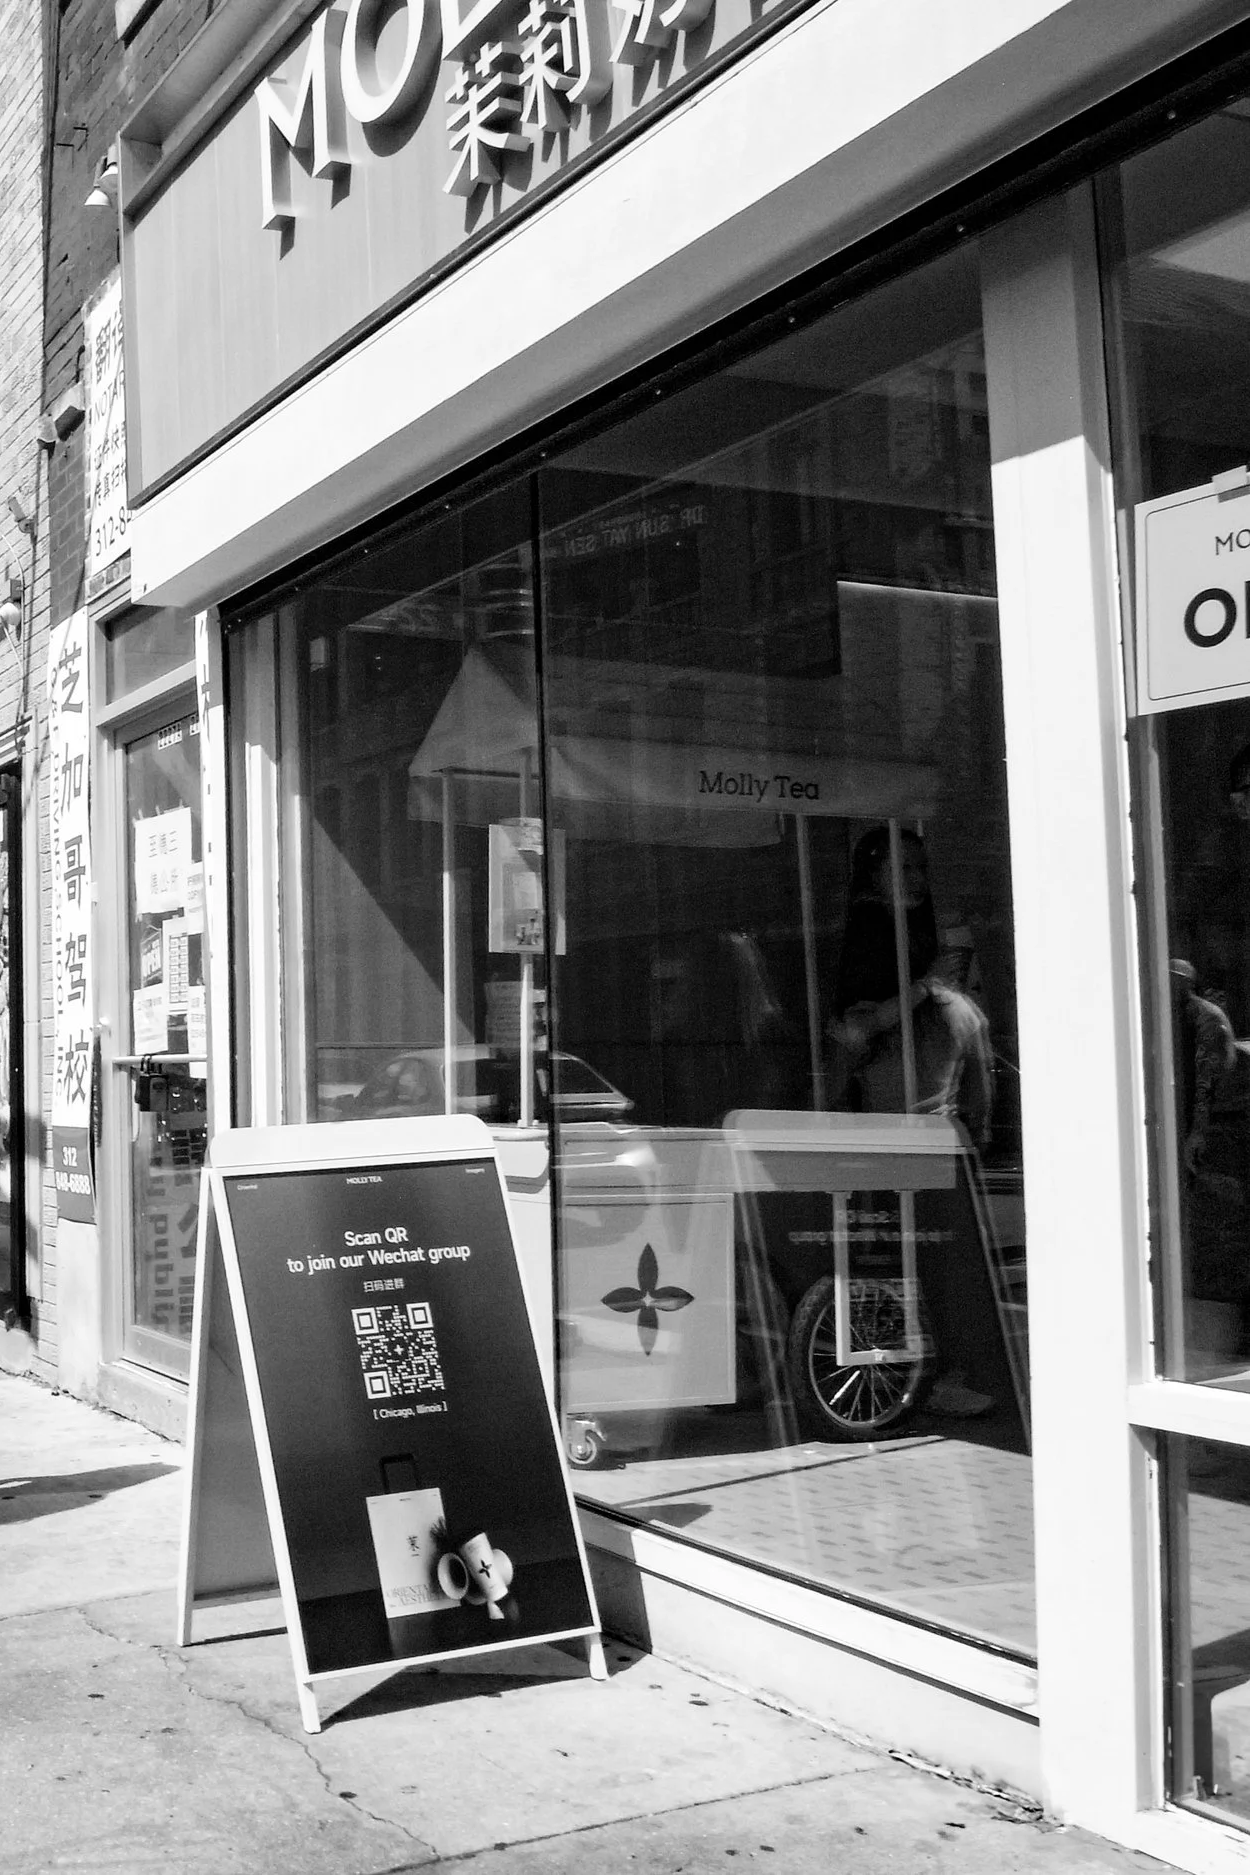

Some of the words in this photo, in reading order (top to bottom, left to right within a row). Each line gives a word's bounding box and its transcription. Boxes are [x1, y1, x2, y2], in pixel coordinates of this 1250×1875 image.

[1184, 580, 1250, 648] O
[698, 770, 770, 803] Molly
[773, 775, 820, 800] Tea
[58, 640, 91, 1104] 芝加哥驾校
[62, 1146, 78, 1167] 312
[344, 1231, 382, 1247] Scan
[384, 1227, 409, 1243] QR
[286, 1257, 305, 1273] to
[307, 1254, 336, 1275] join
[339, 1252, 365, 1268] our
[367, 1247, 426, 1266] Wechat
[428, 1245, 471, 1265] group
